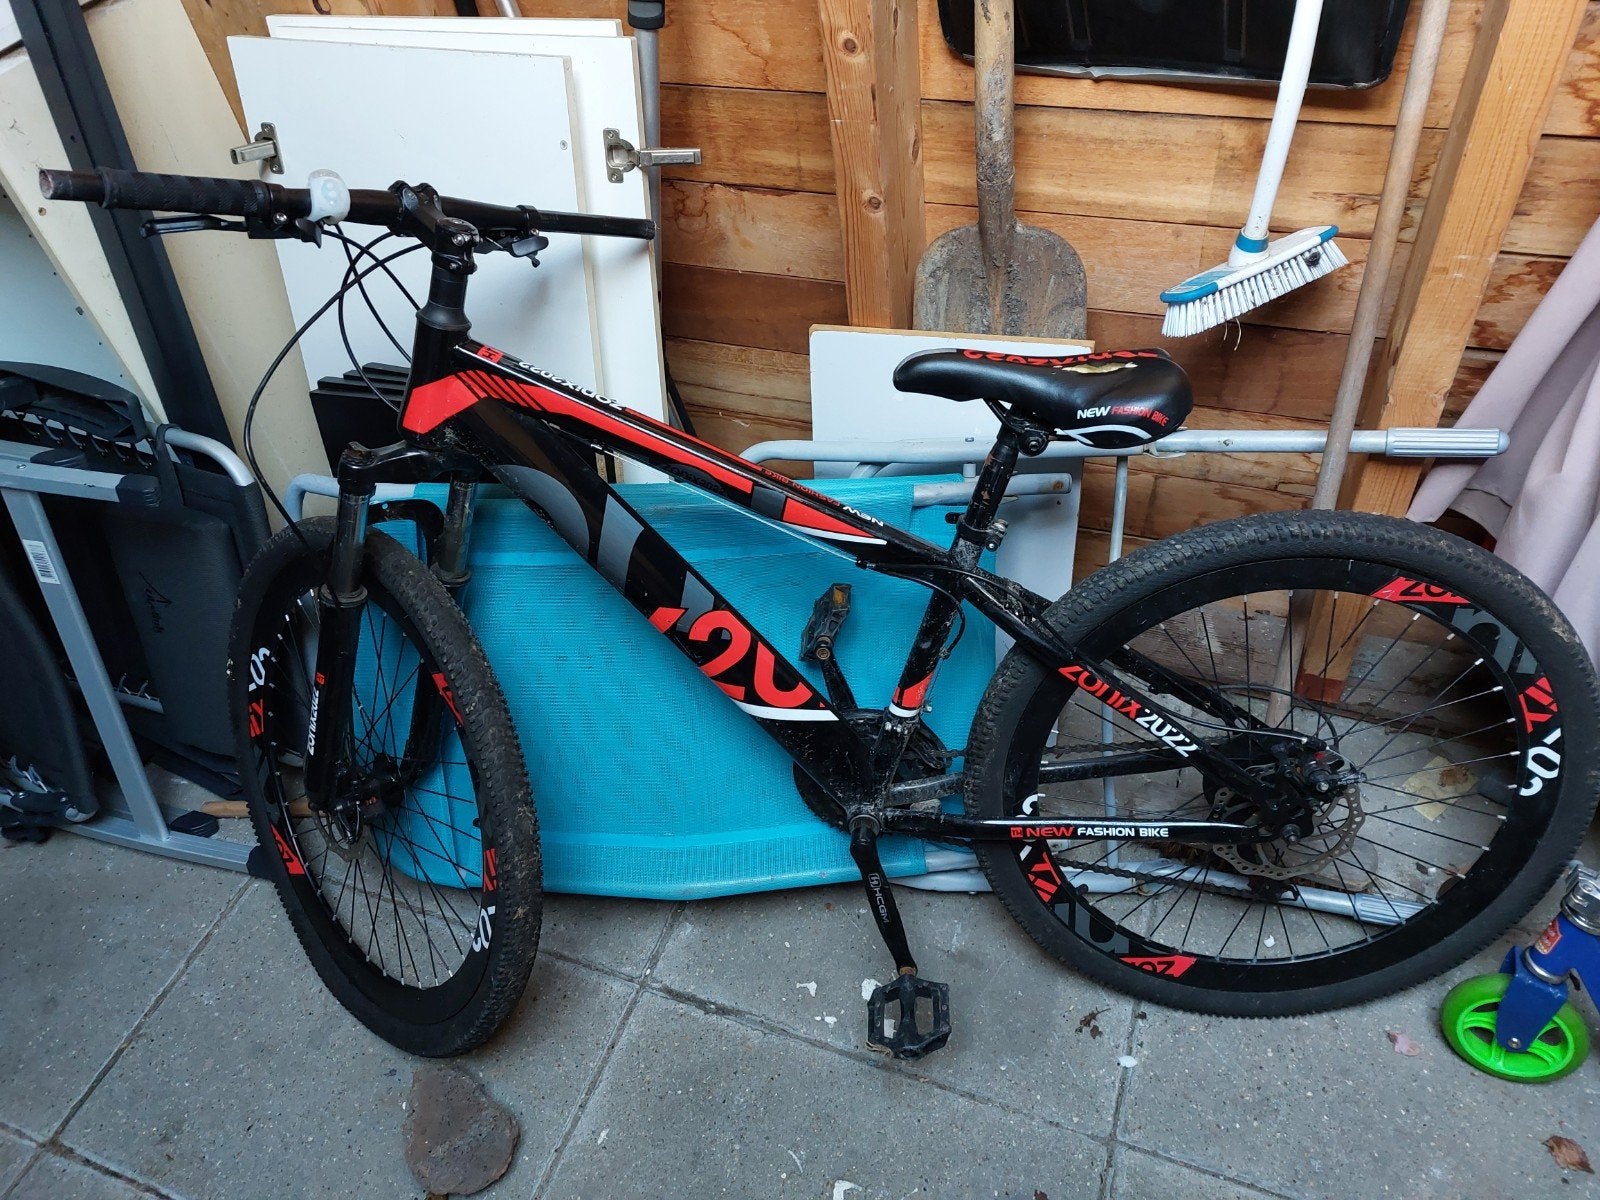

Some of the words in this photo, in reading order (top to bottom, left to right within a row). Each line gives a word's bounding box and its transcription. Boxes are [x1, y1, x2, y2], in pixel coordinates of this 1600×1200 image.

[1076, 405, 1111, 419] NEW
[1111, 406, 1153, 418] FASHION
[1151, 410, 1170, 427] BIKE
[842, 505, 884, 527] NEW
[1026, 826, 1075, 838] NEW
[1077, 827, 1135, 838] FASHION
[1138, 827, 1169, 838] BIKE
